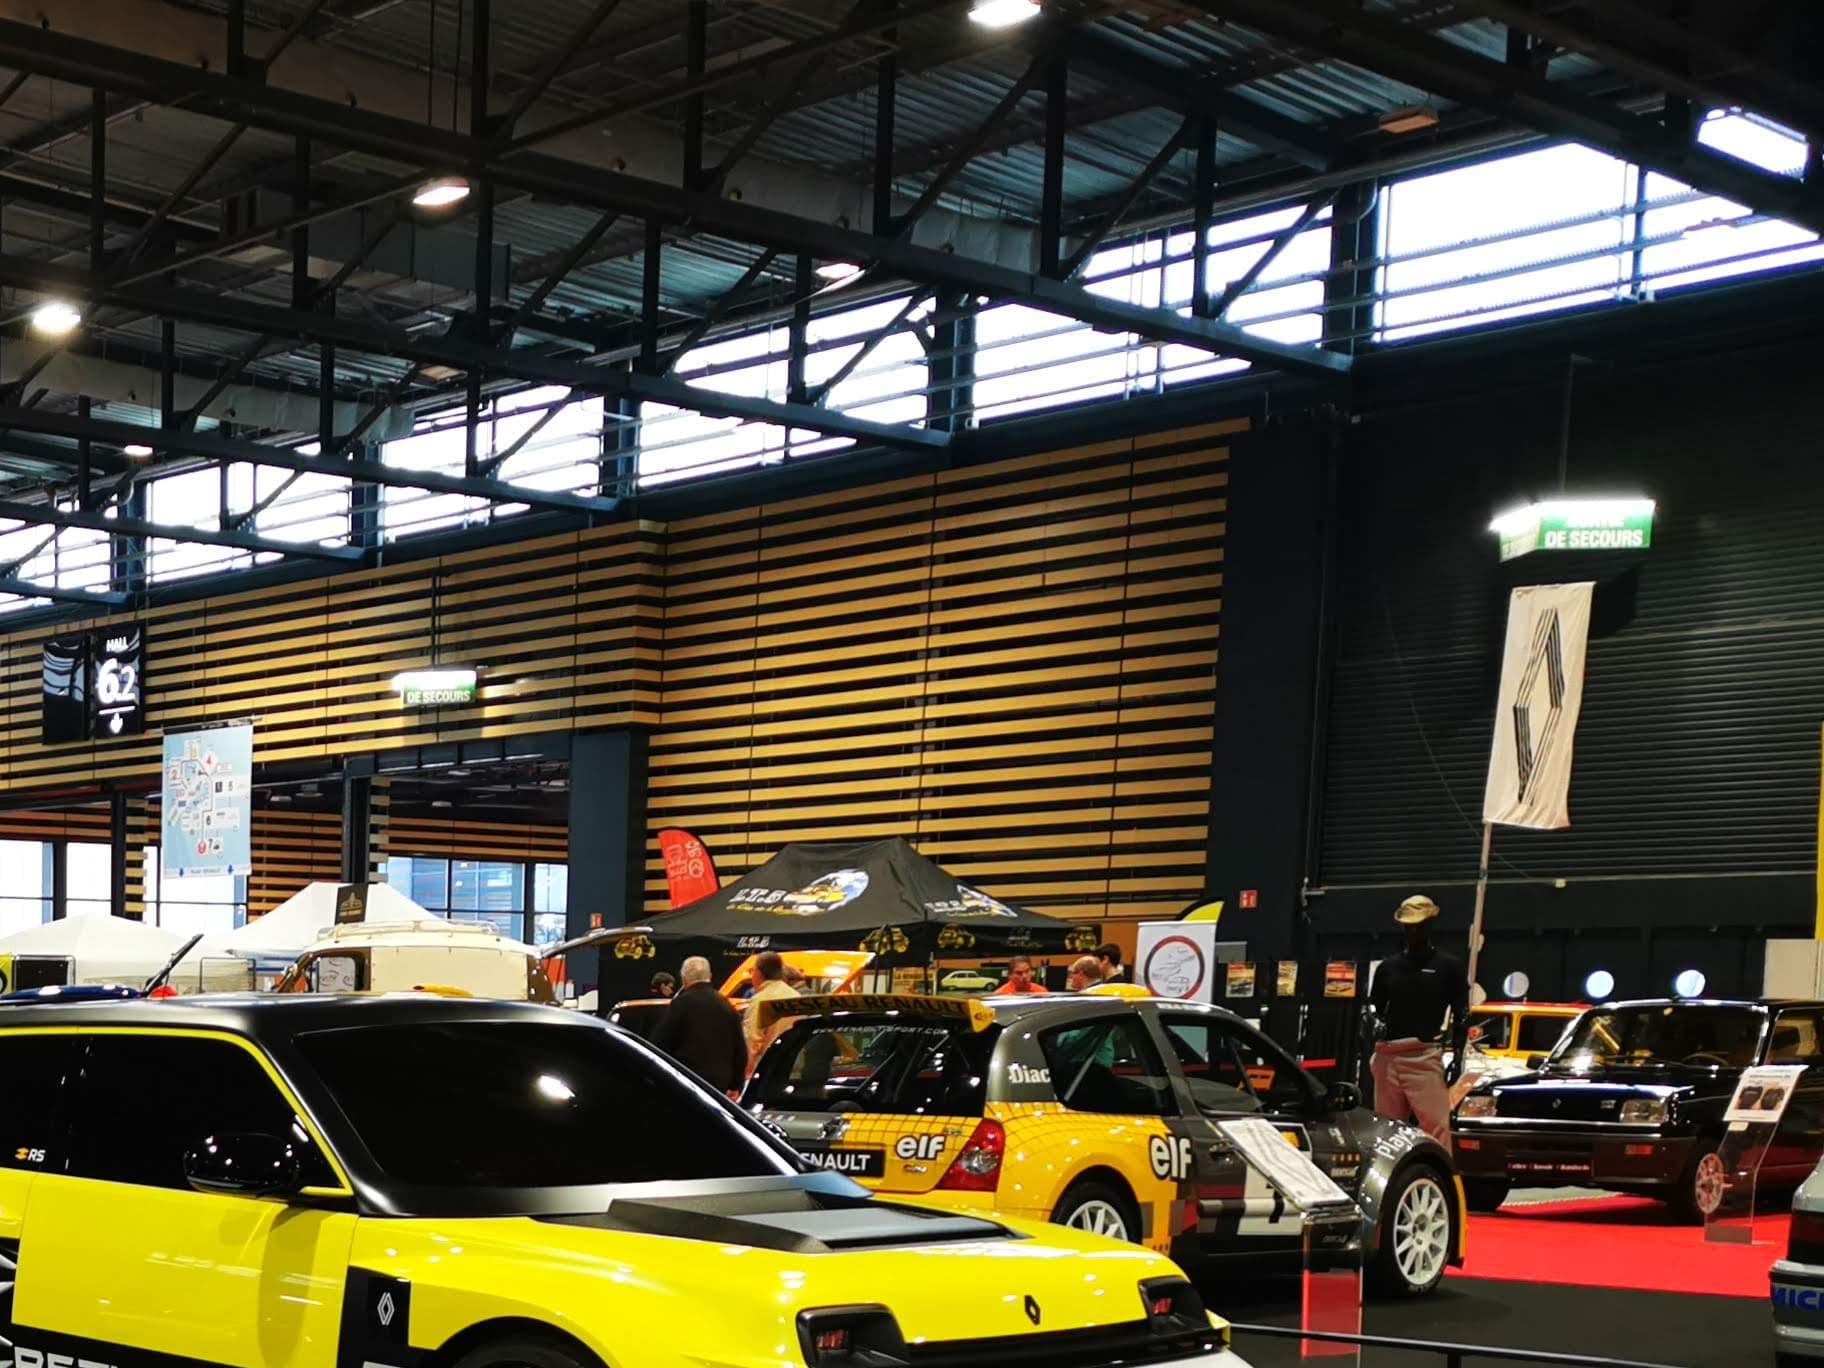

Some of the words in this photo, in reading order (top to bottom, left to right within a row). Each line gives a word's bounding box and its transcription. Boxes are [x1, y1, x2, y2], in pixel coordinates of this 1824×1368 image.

[1544, 529, 1567, 548] DE
[1569, 528, 1643, 548] SECOURS
[106, 636, 128, 652] HALL
[407, 691, 420, 703] DE
[422, 689, 470, 703] SECOURS
[868, 995, 967, 1014] RENAULT
[27, 1148, 46, 1163] RS
[895, 1133, 946, 1160] elf
[799, 1152, 871, 1173] ENAULT
[1150, 1134, 1192, 1181] elf
